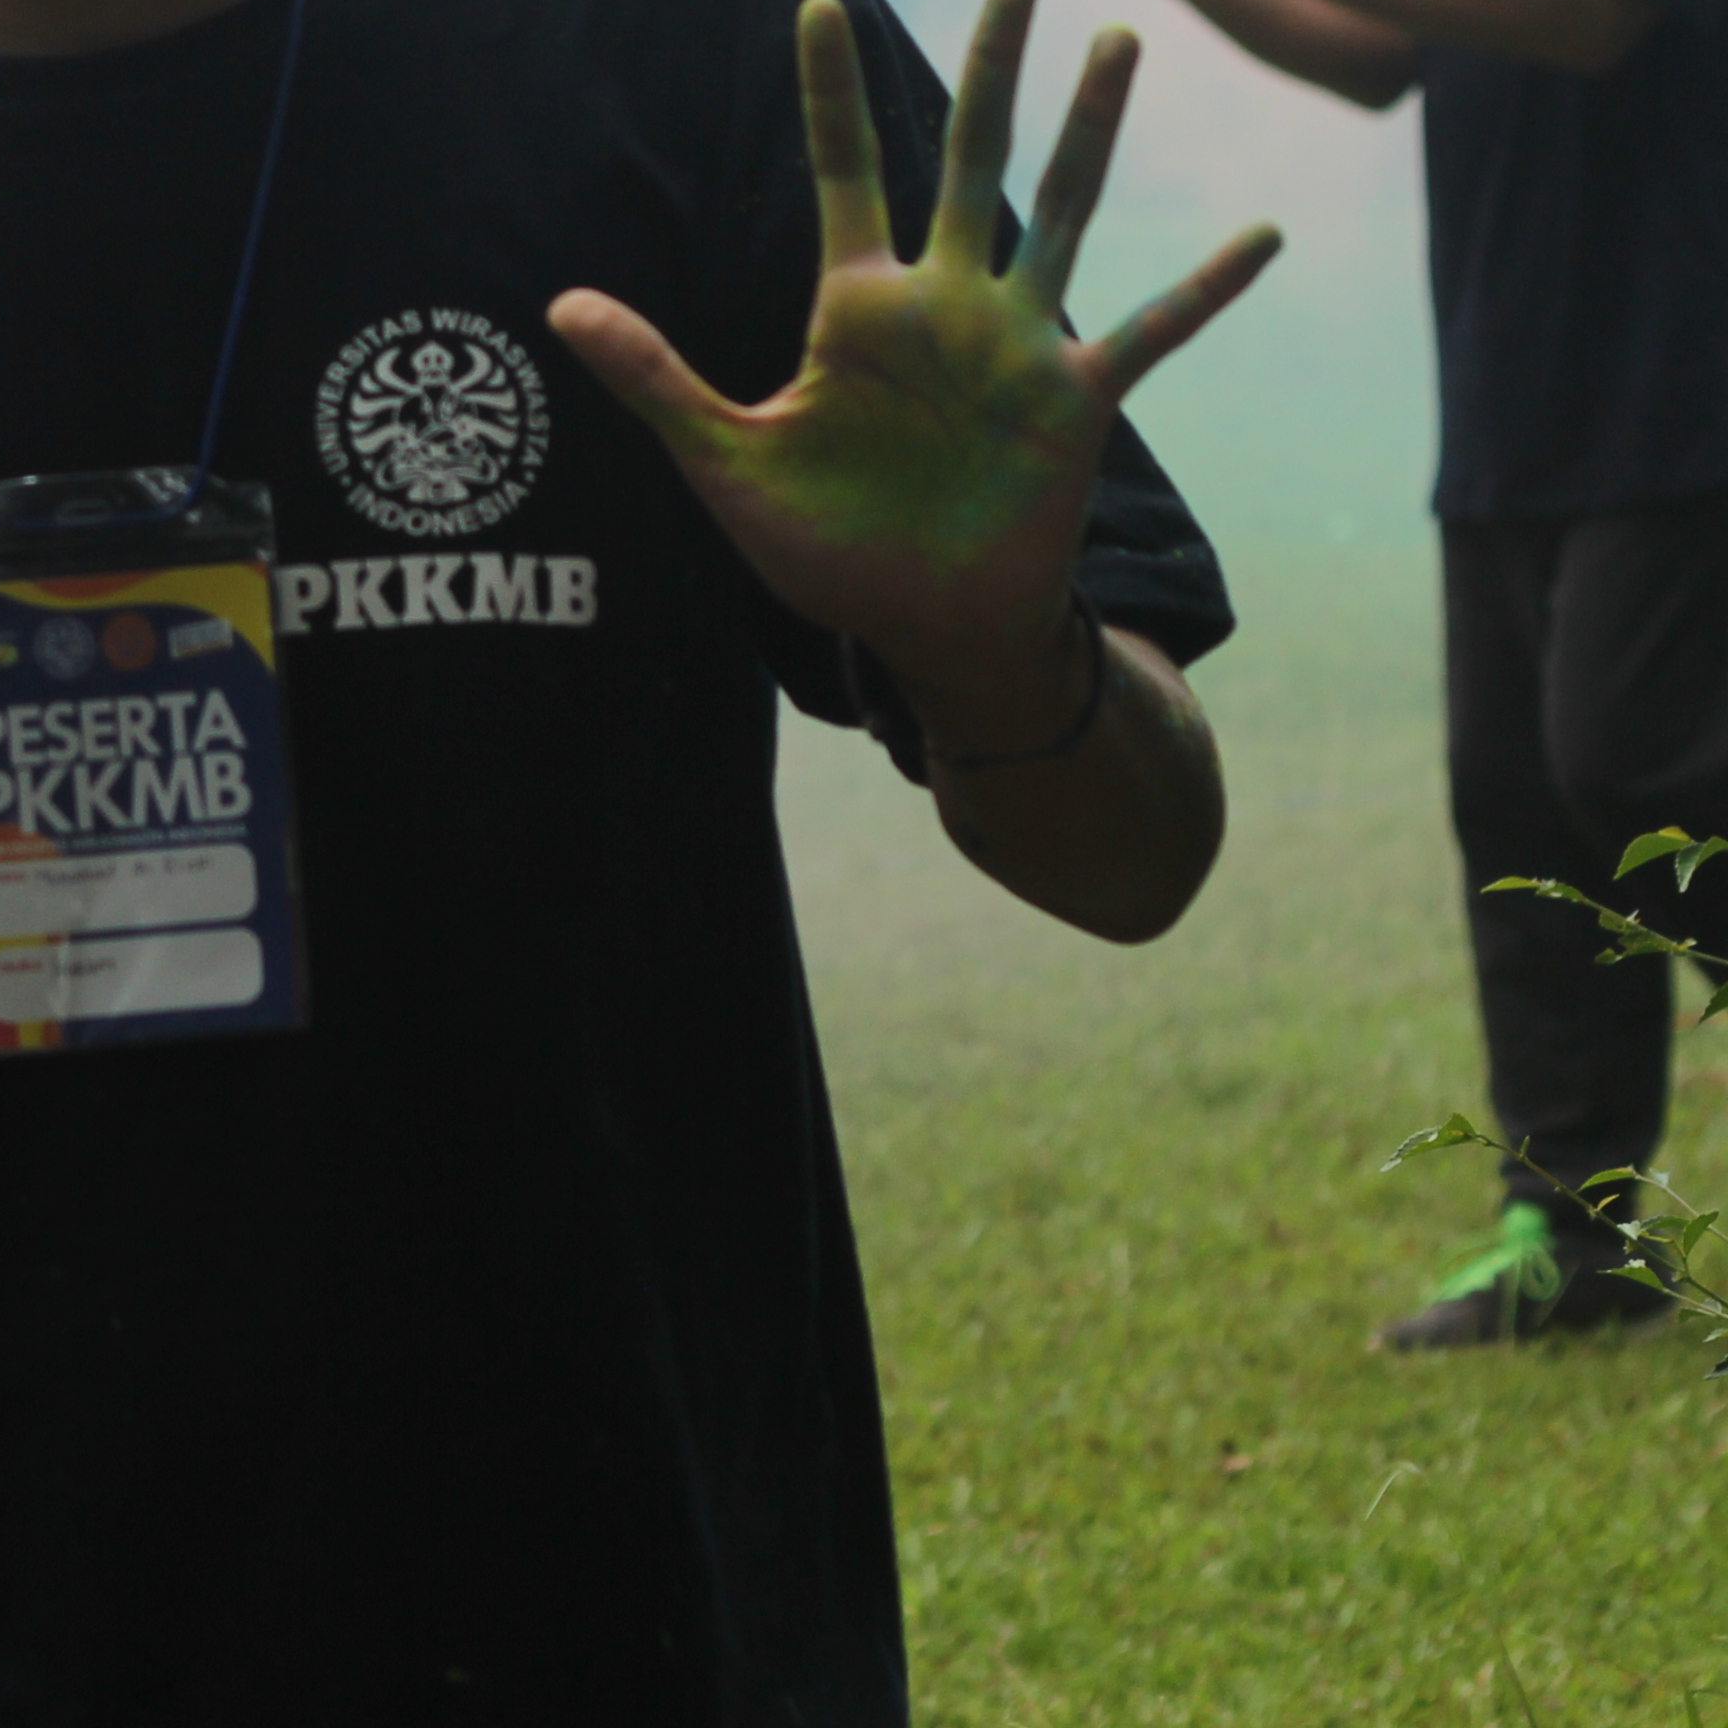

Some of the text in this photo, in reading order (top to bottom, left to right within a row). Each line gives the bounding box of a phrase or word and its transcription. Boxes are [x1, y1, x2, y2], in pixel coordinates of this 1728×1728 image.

[313, 305, 552, 476] UNIVERSITAS WIRASWASTA
[347, 478, 531, 538] INDONESIA
[277, 550, 599, 637] PKKMB
